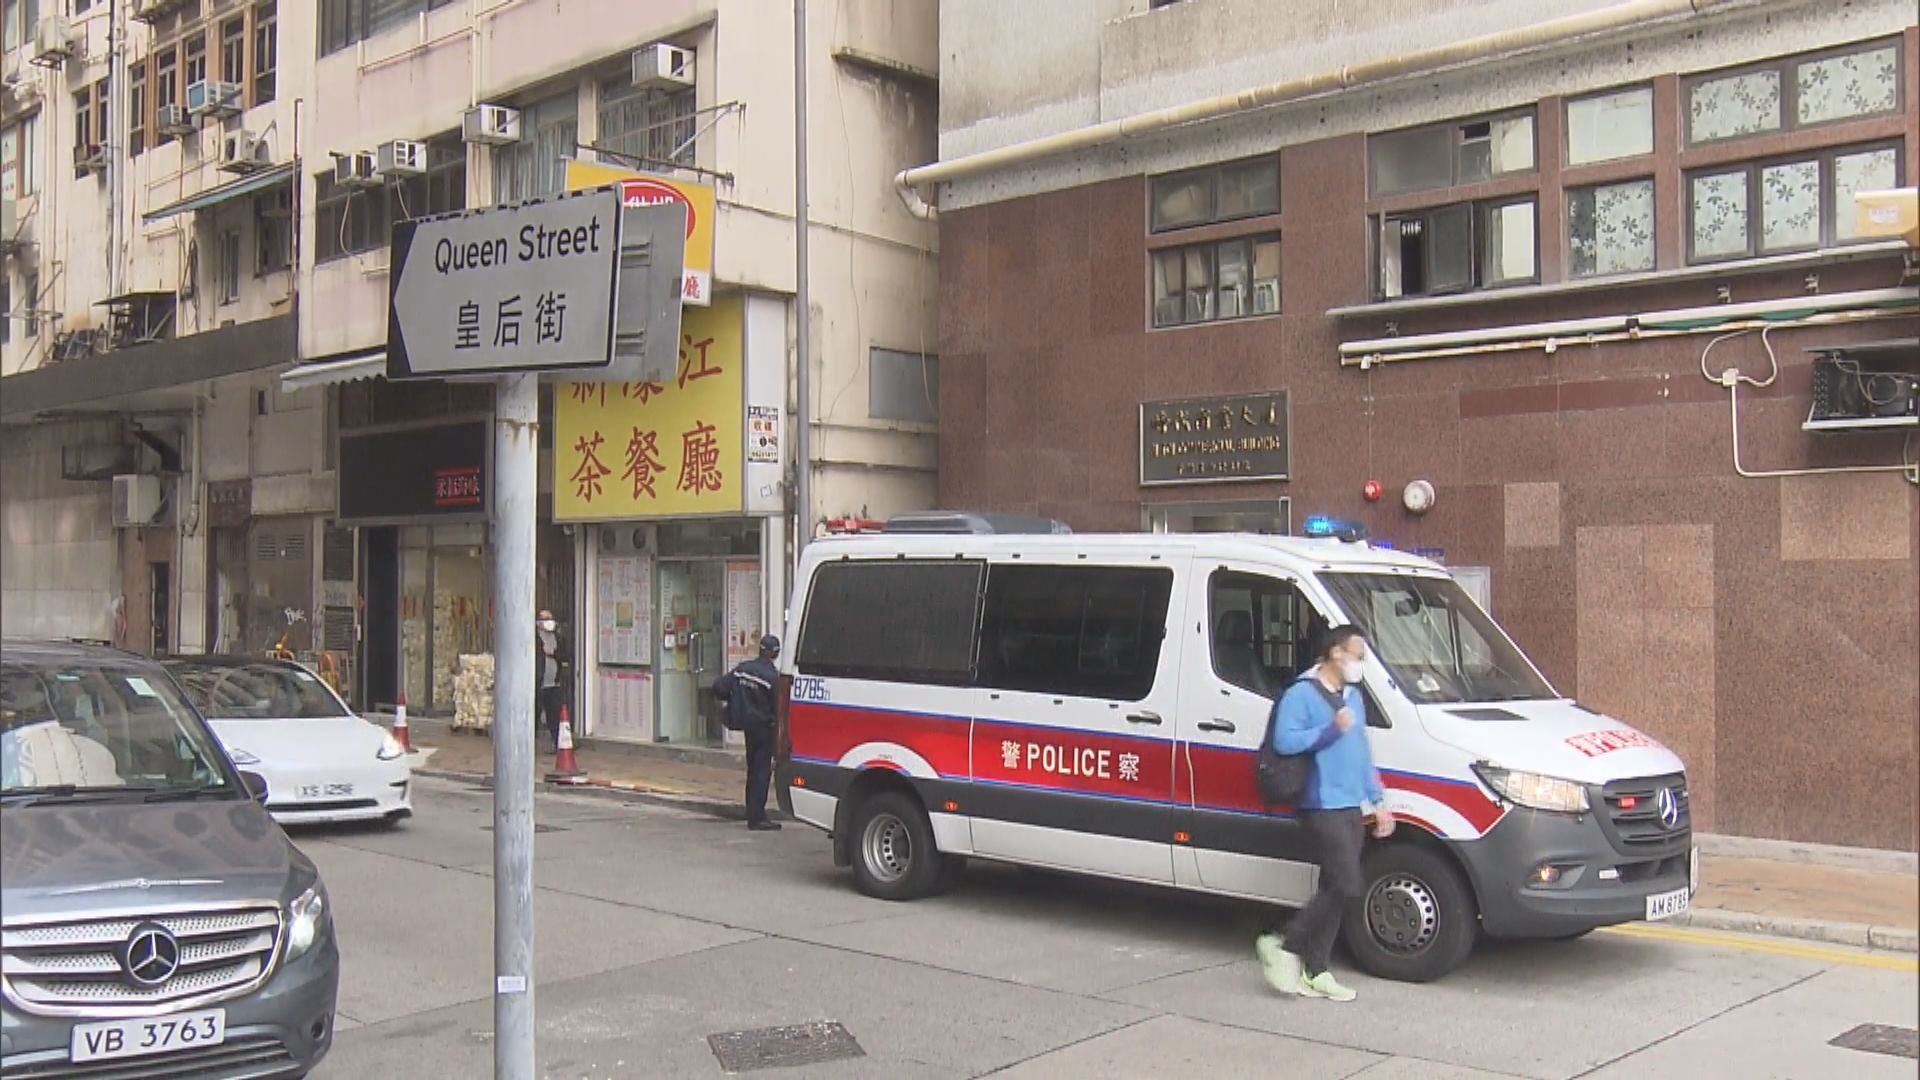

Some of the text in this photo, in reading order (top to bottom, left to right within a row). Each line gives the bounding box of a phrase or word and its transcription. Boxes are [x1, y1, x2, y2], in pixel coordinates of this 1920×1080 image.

[435, 215, 600, 275] Queen Street
[454, 292, 568, 350] 皇后街
[570, 420, 723, 503] 茶餐廳
[794, 677, 824, 700] 8785
[1001, 740, 1140, 782] 警 POLICE 察
[1652, 892, 1687, 917] AM 8785
[84, 1017, 216, 1055] VB 3763
